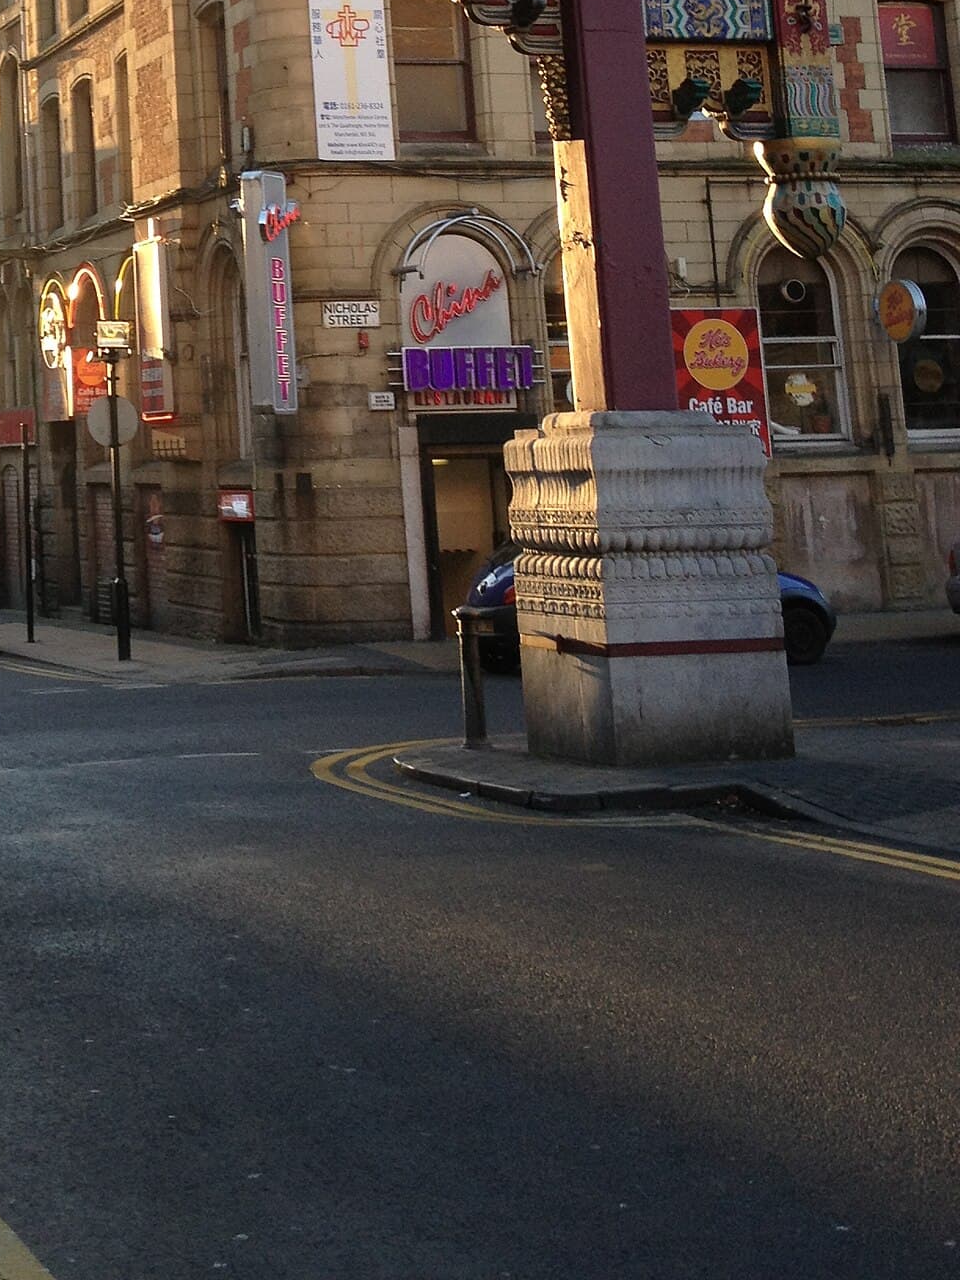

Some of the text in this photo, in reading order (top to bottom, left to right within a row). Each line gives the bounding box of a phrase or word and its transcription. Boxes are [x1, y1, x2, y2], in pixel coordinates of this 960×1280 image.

[323, 302, 378, 314] NICHOLAS
[328, 314, 369, 325] STREET
[411, 269, 502, 344] China
[271, 257, 290, 403] BUFFET
[401, 345, 534, 392] BUFFET
[688, 396, 754, 414] Café Bar
